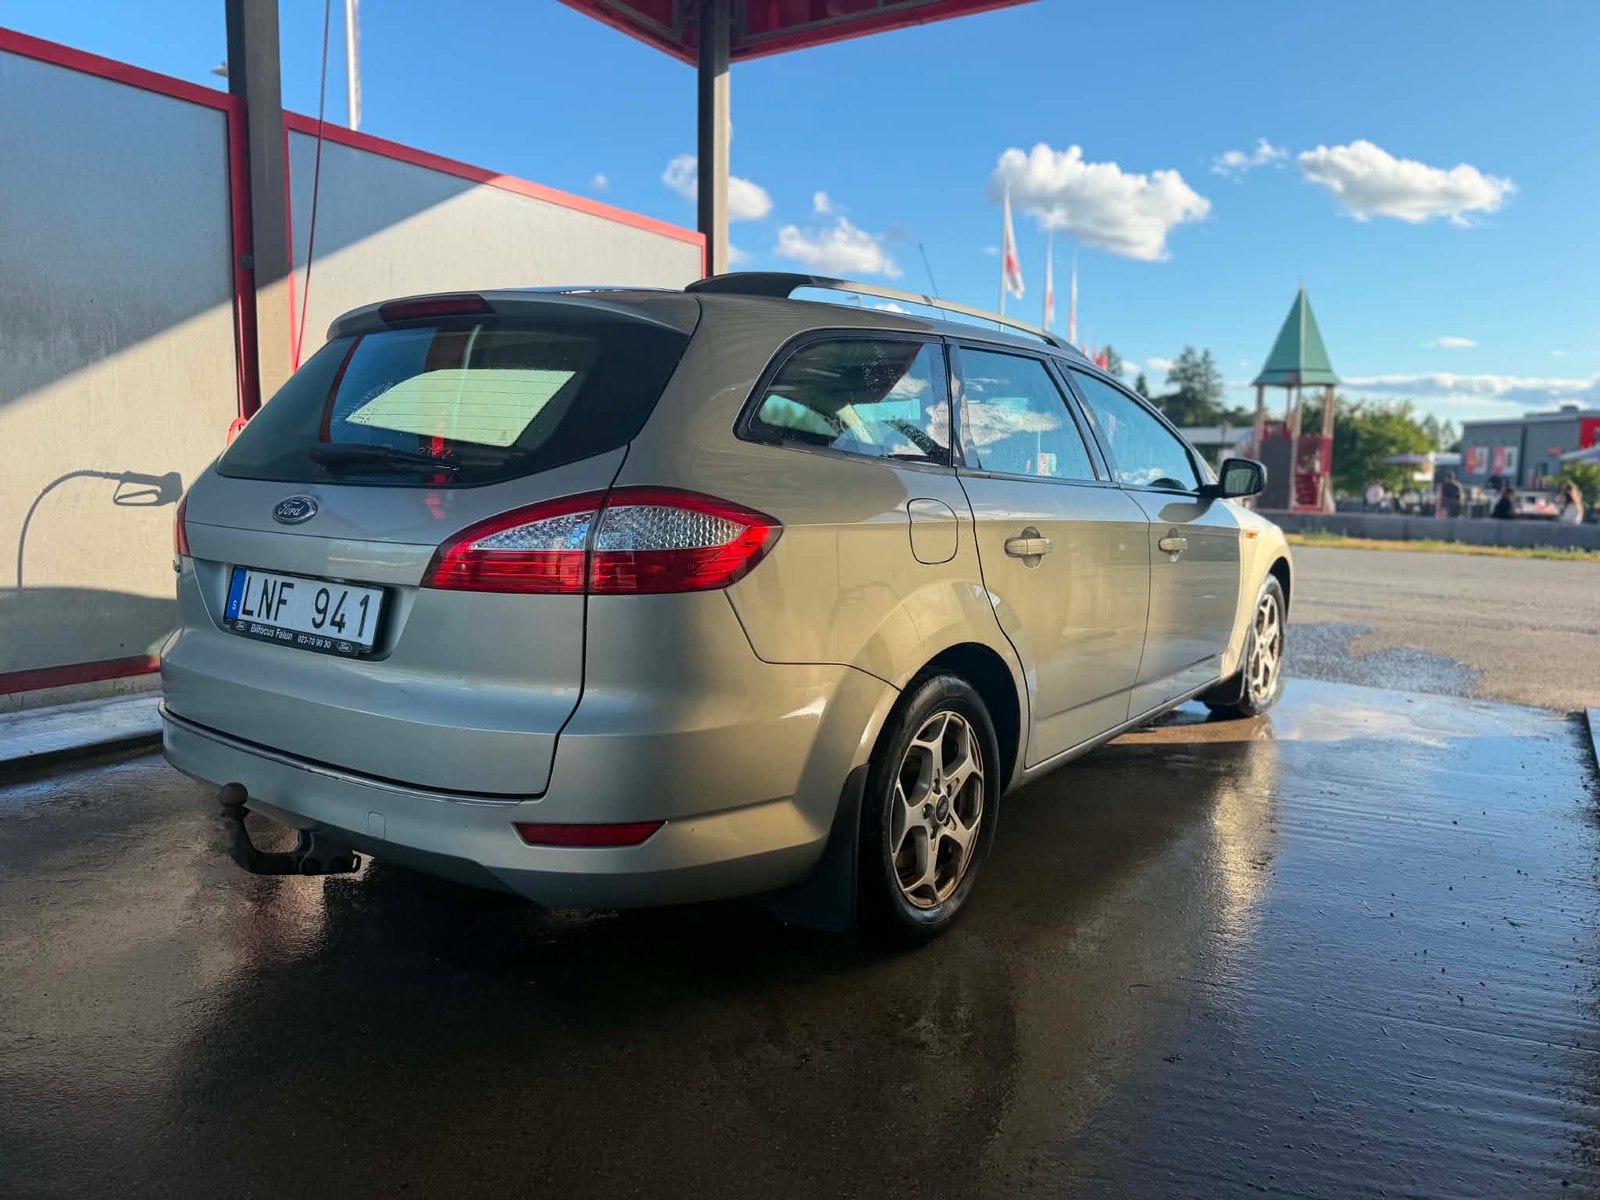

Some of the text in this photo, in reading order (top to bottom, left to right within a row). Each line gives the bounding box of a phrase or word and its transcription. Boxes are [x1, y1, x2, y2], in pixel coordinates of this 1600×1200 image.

[277, 503, 305, 517] Ford
[231, 600, 237, 610] S
[242, 576, 371, 637] LNF 941
[250, 623, 275, 637] Bilfocus
[275, 628, 293, 640] Falun
